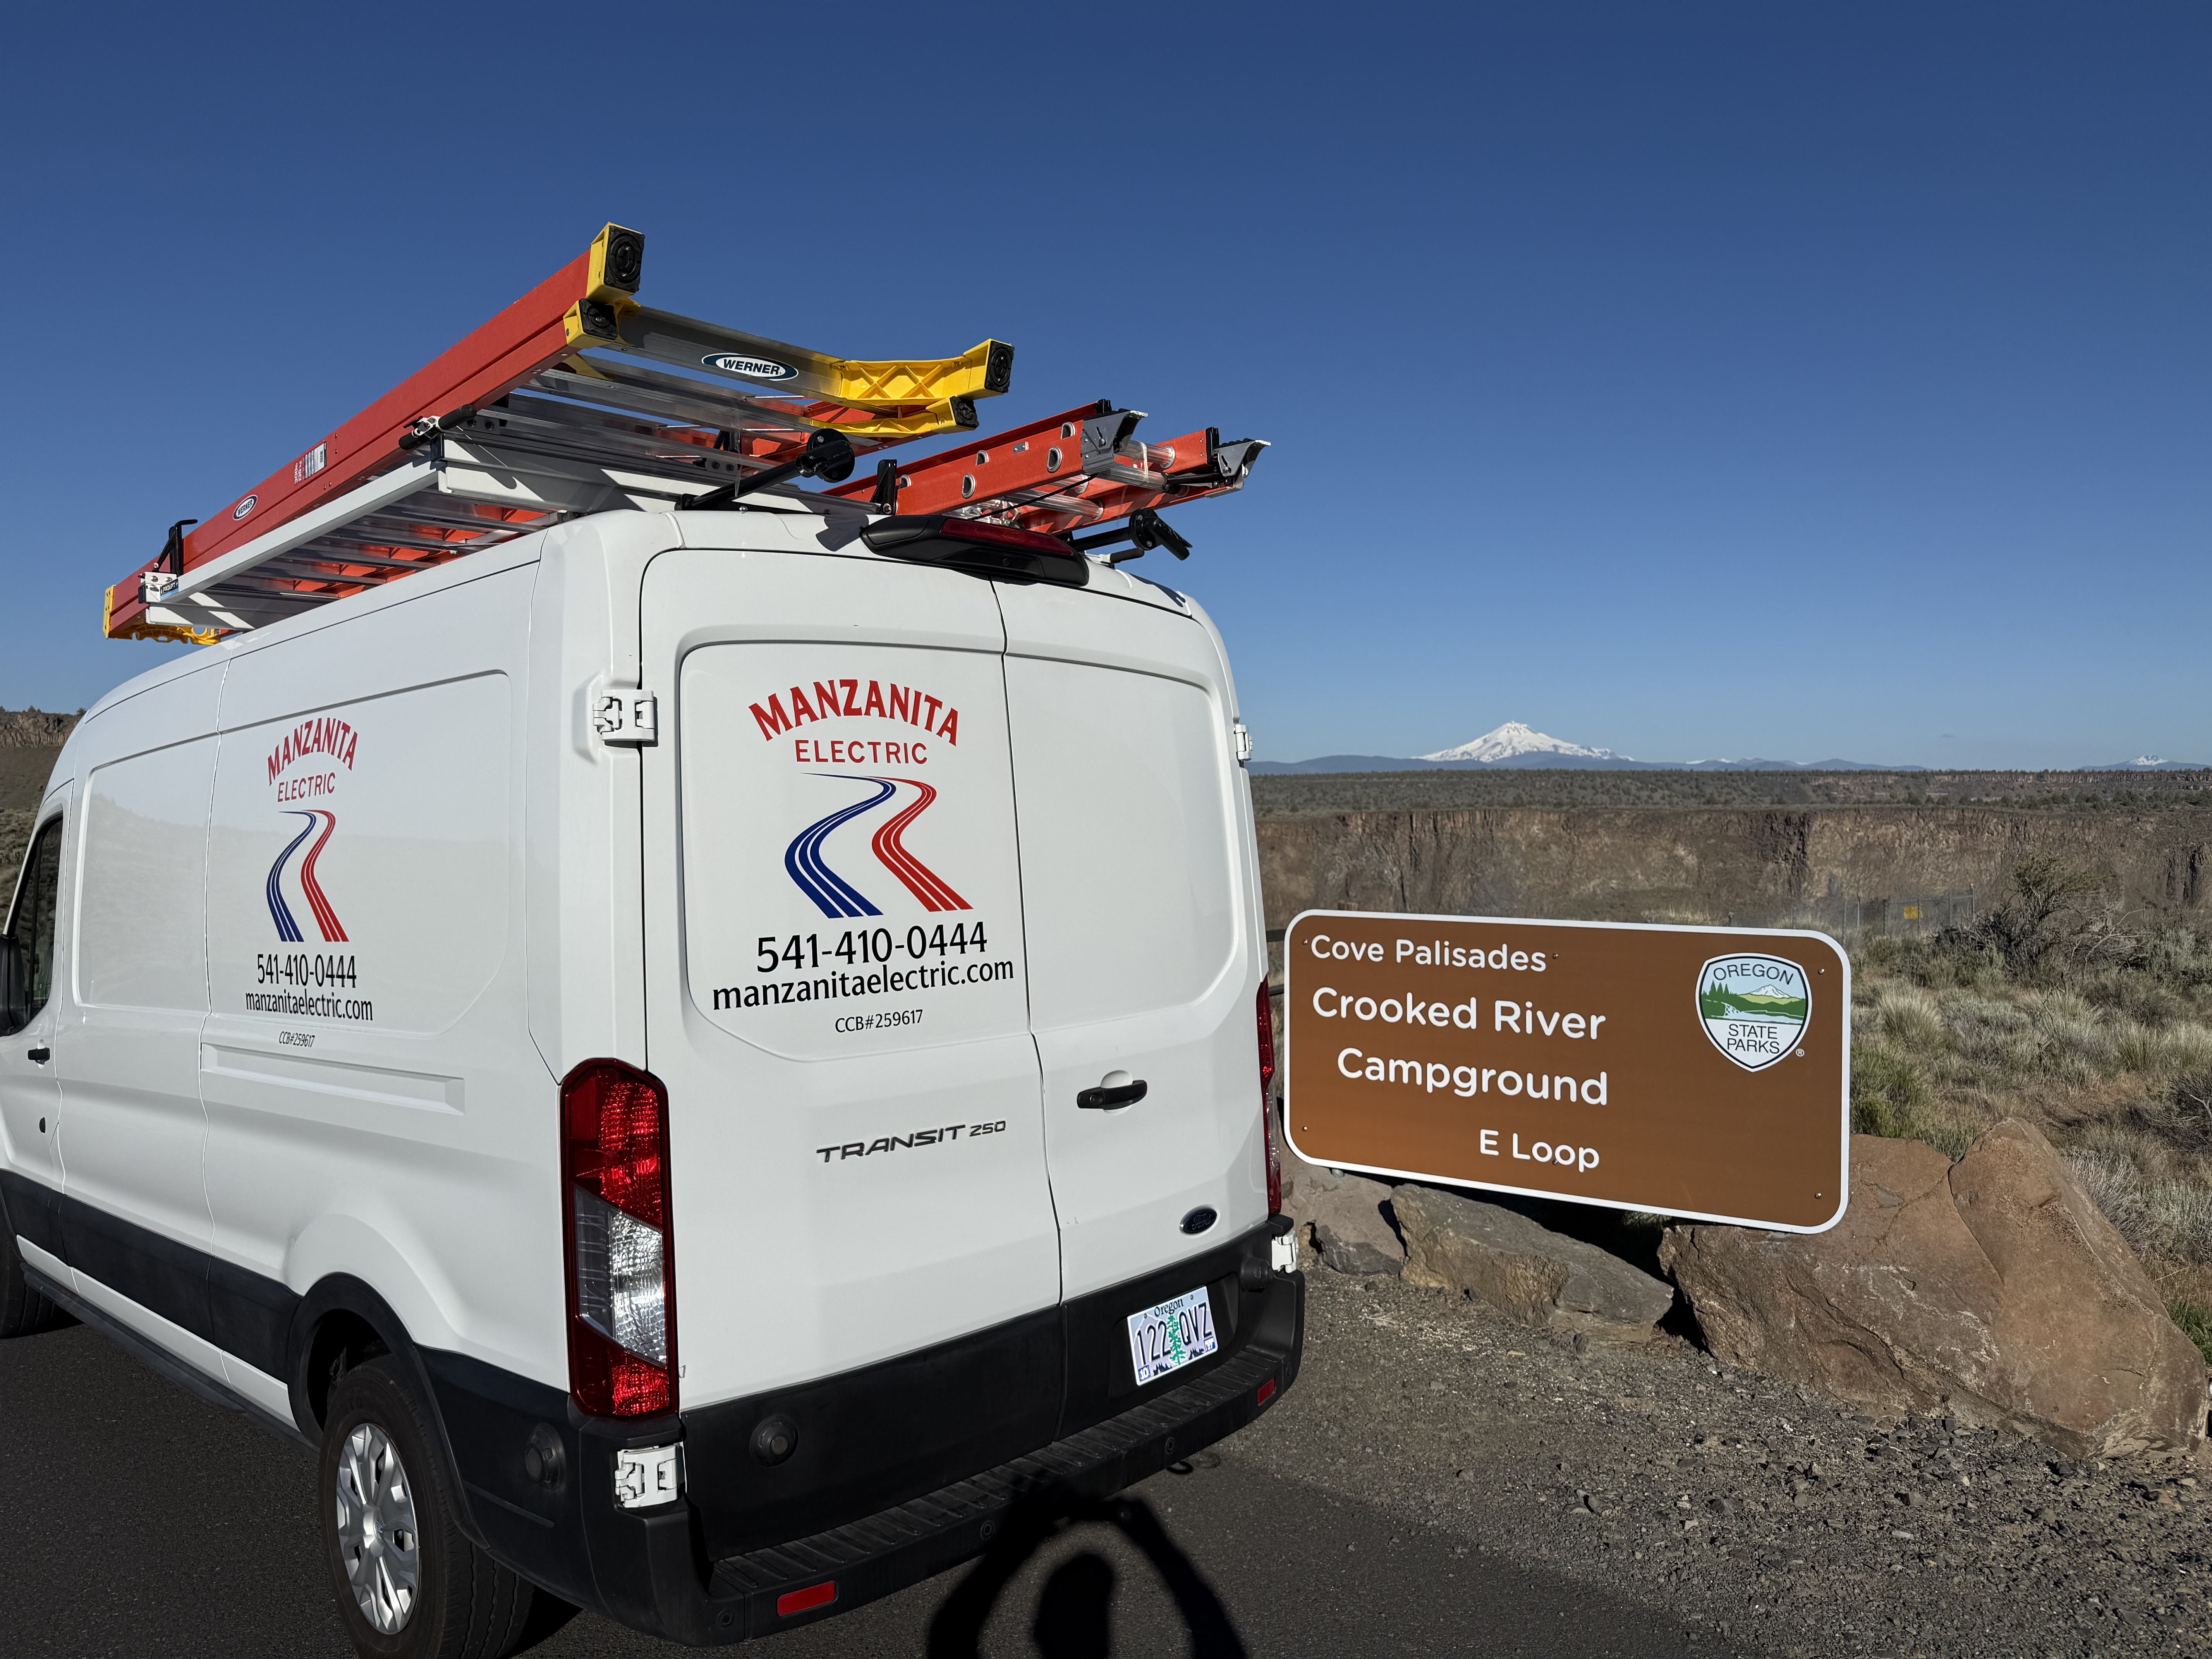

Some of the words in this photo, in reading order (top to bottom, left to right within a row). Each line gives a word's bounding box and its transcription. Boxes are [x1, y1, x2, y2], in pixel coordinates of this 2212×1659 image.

[723, 359, 780, 375] WERNER
[749, 680, 958, 746] MANZANITA
[268, 718, 357, 786] MANZANITA
[795, 740, 927, 764] ELECTRIC
[277, 772, 335, 802] ELECTRIC
[757, 921, 988, 973] 541-410-0444
[1311, 934, 1384, 962] Cove
[1396, 939, 1546, 972] Palisades
[258, 953, 357, 989] 541-410-0444
[713, 959, 1014, 1010] manzanitaelectric.com
[1713, 963, 1793, 985] OREGON
[246, 988, 373, 1021] manzanitaelectric.com
[835, 1009, 923, 1033] CCB#259617
[1312, 987, 1477, 1030] Crooked
[1494, 1000, 1606, 1040] River
[279, 1031, 315, 1048] CCB#259617
[1727, 1037, 1780, 1054] PARKS
[1728, 1024, 1778, 1039] STATE
[1337, 1047, 1607, 1106] Campground
[816, 1124, 966, 1163] TRANSIT
[969, 1120, 1006, 1137] 250
[1480, 1129, 1499, 1156] E
[1512, 1132, 1600, 1173] Loop
[1192, 1212, 1211, 1230] Ford
[1154, 1298, 1184, 1317] Oregon
[1137, 1321, 1171, 1365] 122
[1178, 1302, 1212, 1346] QVZ
[1139, 1369, 1149, 1380] 10
